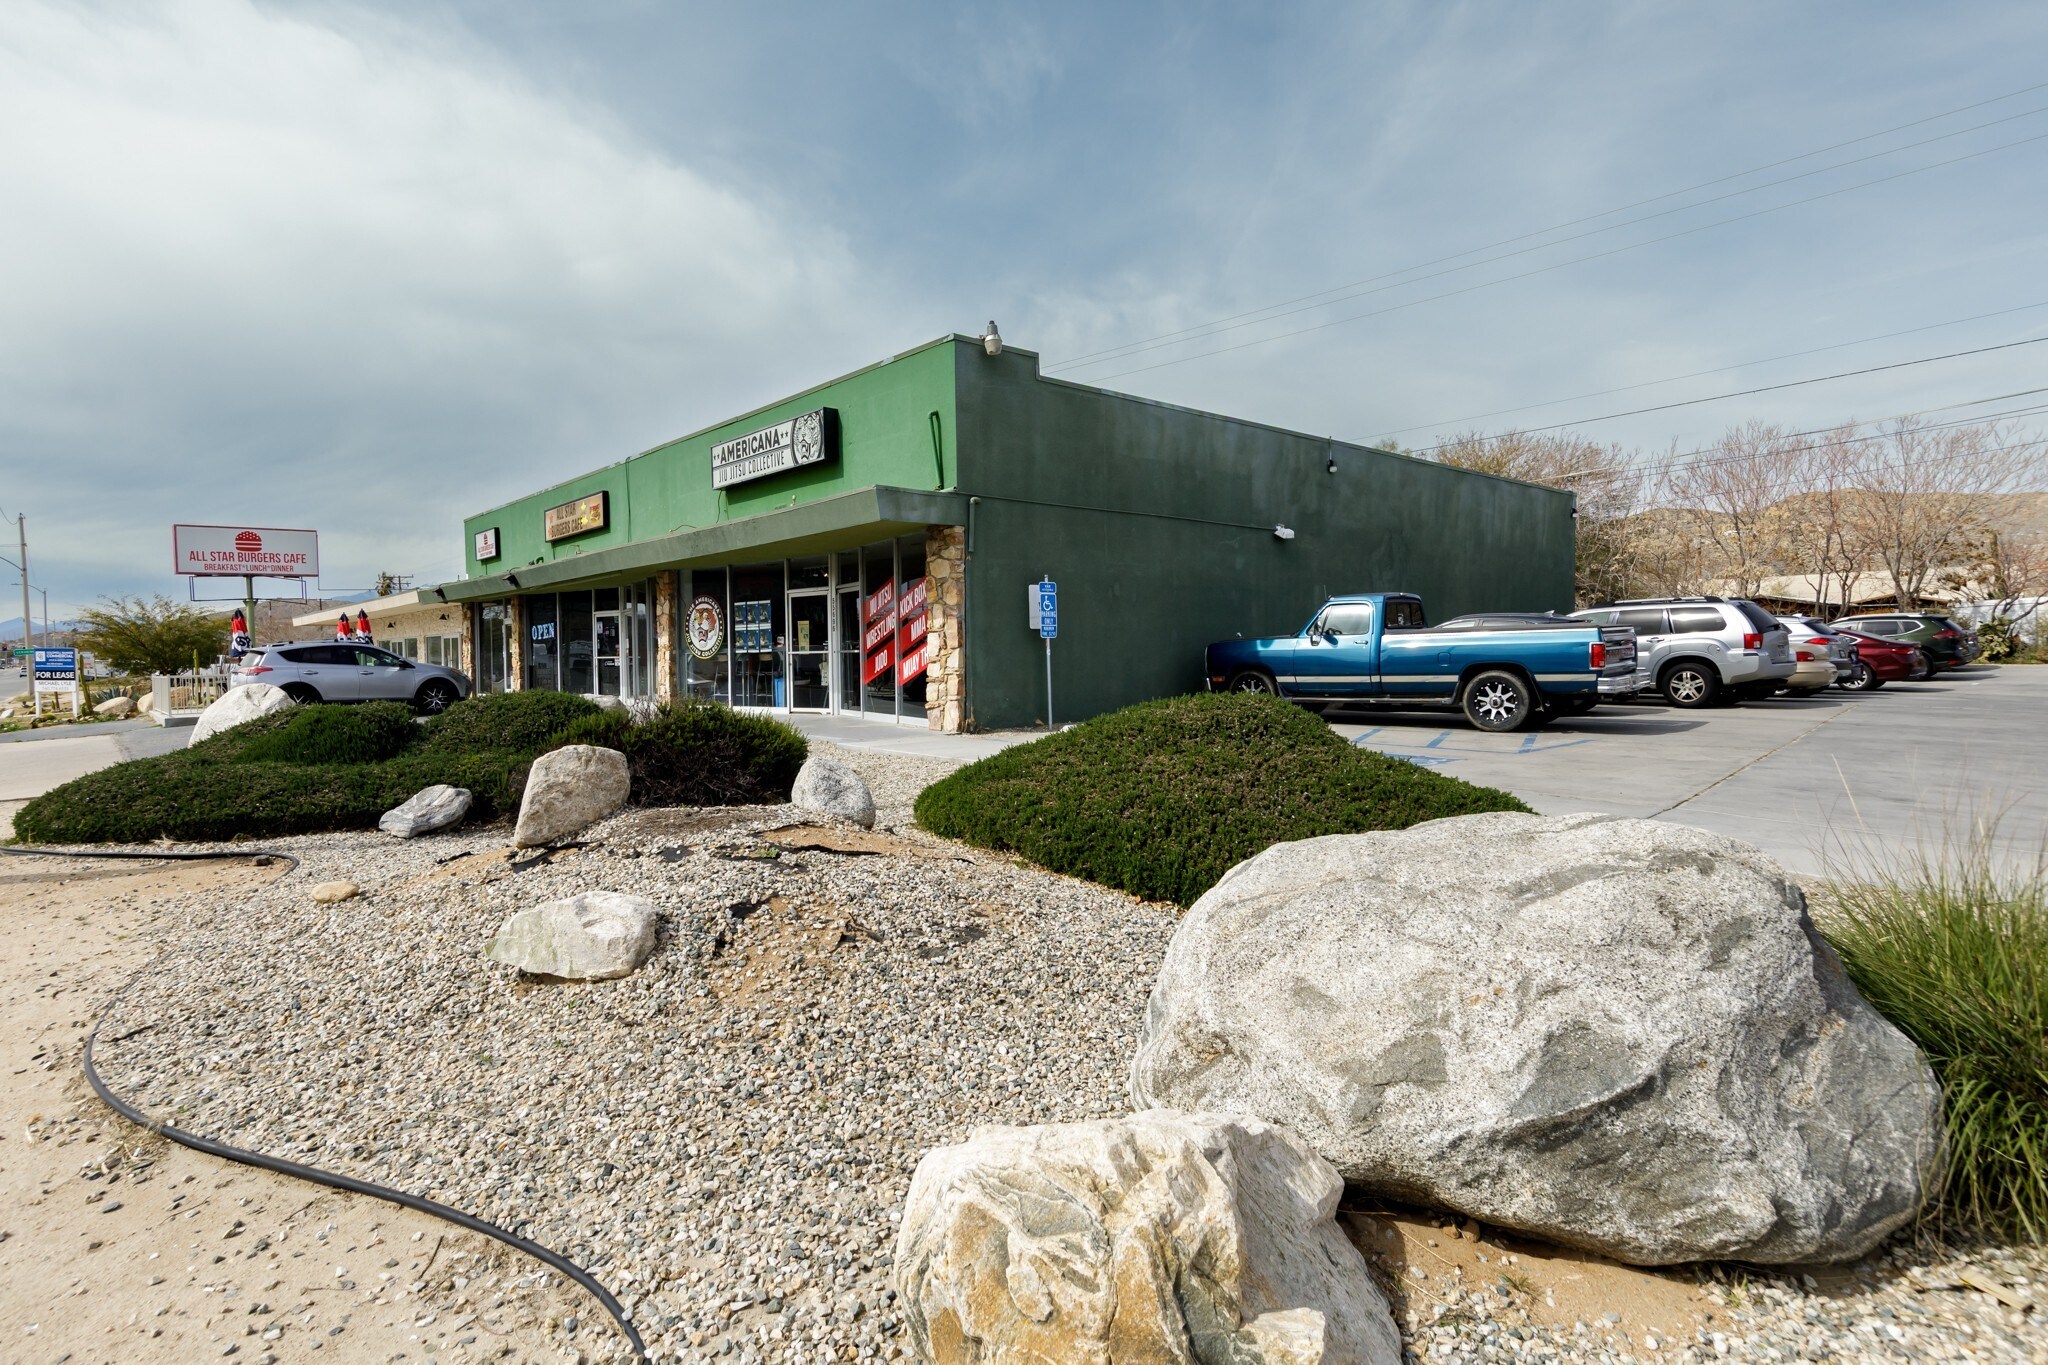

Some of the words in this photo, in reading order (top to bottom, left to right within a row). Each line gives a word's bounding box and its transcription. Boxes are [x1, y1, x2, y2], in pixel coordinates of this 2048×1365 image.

[720, 428, 780, 464] AMERICANA
[719, 467, 728, 484] JIU
[729, 462, 746, 480] JITSU
[748, 450, 785, 475] COLLECTIVE
[556, 506, 565, 520] ALL
[564, 502, 577, 518] STAR
[551, 520, 571, 539] BURGERS
[571, 516, 583, 532] CAFE
[189, 550, 208, 562] ALL
[210, 550, 235, 562] STAR
[237, 551, 281, 563] BURGERS
[283, 553, 307, 564] CAFE
[695, 597, 720, 614] AMERICANA
[869, 595, 877, 617] JIU
[877, 582, 892, 609] JITSU
[899, 591, 914, 618] KICK
[531, 622, 555, 640] OPEN
[865, 611, 896, 650] WRESTLING
[910, 614, 927, 642] MMA
[874, 649, 888, 674] JUDO
[902, 651, 920, 680] MUAY
[35, 671, 51, 679] FOR
[52, 671, 75, 679] LEASE
